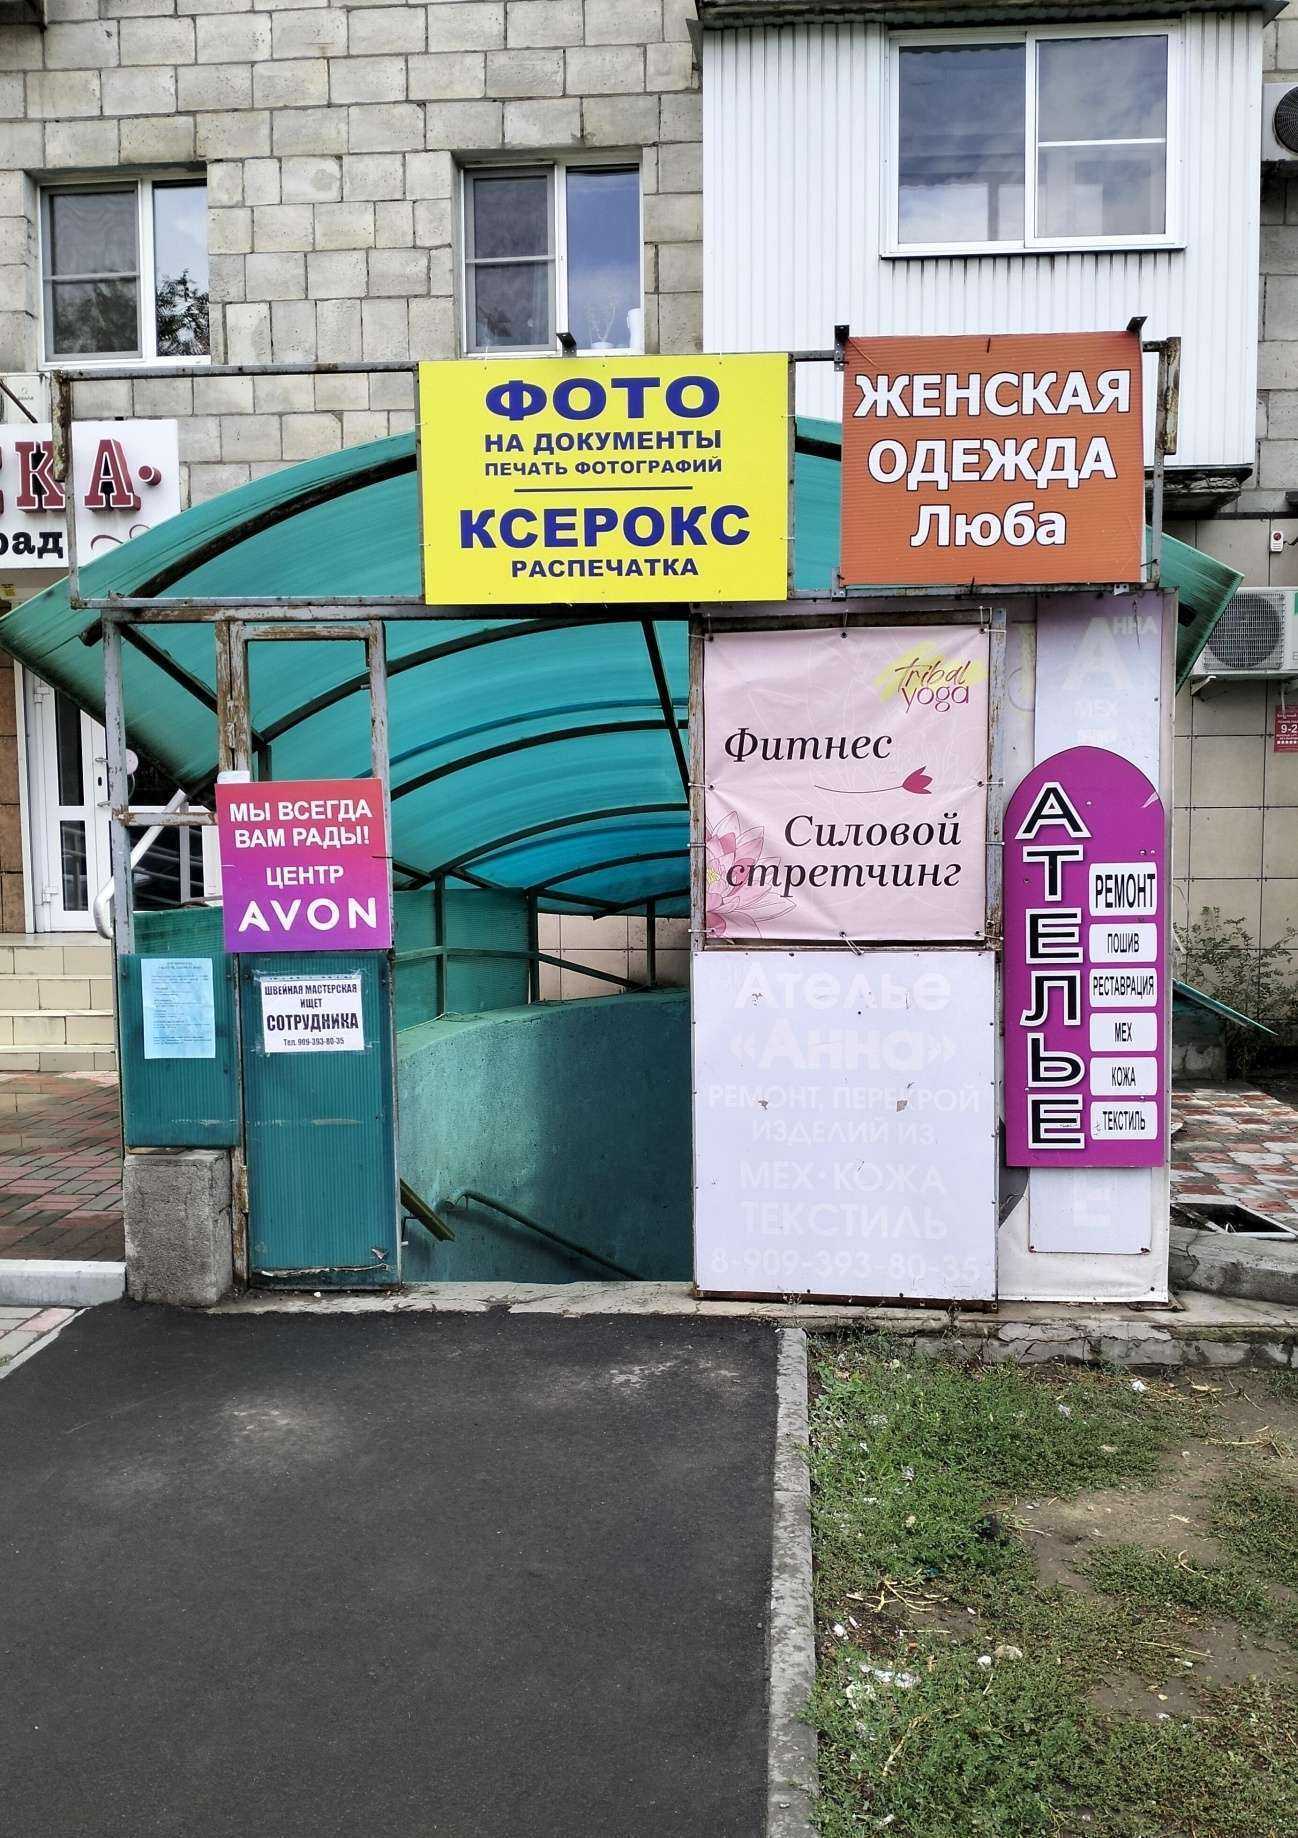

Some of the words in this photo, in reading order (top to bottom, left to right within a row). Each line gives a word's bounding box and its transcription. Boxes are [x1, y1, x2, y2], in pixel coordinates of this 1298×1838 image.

[485, 375, 721, 421] ФОТО
[853, 369, 1132, 418] ЖЕНСКАЯ
[485, 433, 524, 452] НА
[533, 430, 722, 455] ДОКУМЕНТЫ
[485, 461, 568, 476] ПЕЧАТЬ
[575, 455, 722, 475] ФОТОГРАФИЙ
[867, 436, 1118, 491] ОДЕЖДА
[459, 504, 750, 549] КСЕРОКС
[909, 501, 1067, 547] Люба
[511, 557, 699, 577] РАСПЕЧАТКА
[894, 657, 971, 693] tribal
[901, 685, 969, 713] yoga
[724, 727, 892, 762] Фитнес
[229, 802, 270, 822] МЫ
[278, 799, 373, 822] ВСЕГДА
[234, 828, 286, 848] ВАМ
[292, 825, 370, 849] РАДЫ!
[784, 812, 962, 848] Силовой
[266, 865, 344, 889] ЦЕНТР
[725, 862, 962, 898] стретчинг
[1095, 873, 1156, 908] РЕМОНТ
[238, 897, 377, 932] AVON
[1107, 933, 1140, 953] ПОШИВ
[1015, 781, 1093, 1150] АТЕЛЬЕ
[264, 984, 303, 995] ШВЕЙНАЯ
[305, 984, 357, 994] МАСТЕРСКАЯ
[734, 961, 952, 1011] Ателье
[1093, 976, 1155, 999] РЕСТАВРАЦИЯ
[300, 998, 322, 1009] ИЩЕТ
[267, 1013, 359, 1032] СОТРУДНИКА
[1114, 1022, 1132, 1042] МЕХ
[1111, 1066, 1136, 1087] КОЖА
[708, 1085, 825, 1111] РЕМОНТ,
[752, 1117, 888, 1146] ИЗДЕЛИЙ
[1102, 1110, 1146, 1131] ТЕКСТИЛЬ
[740, 1200, 948, 1240] ТЕКСТИЛЬ
